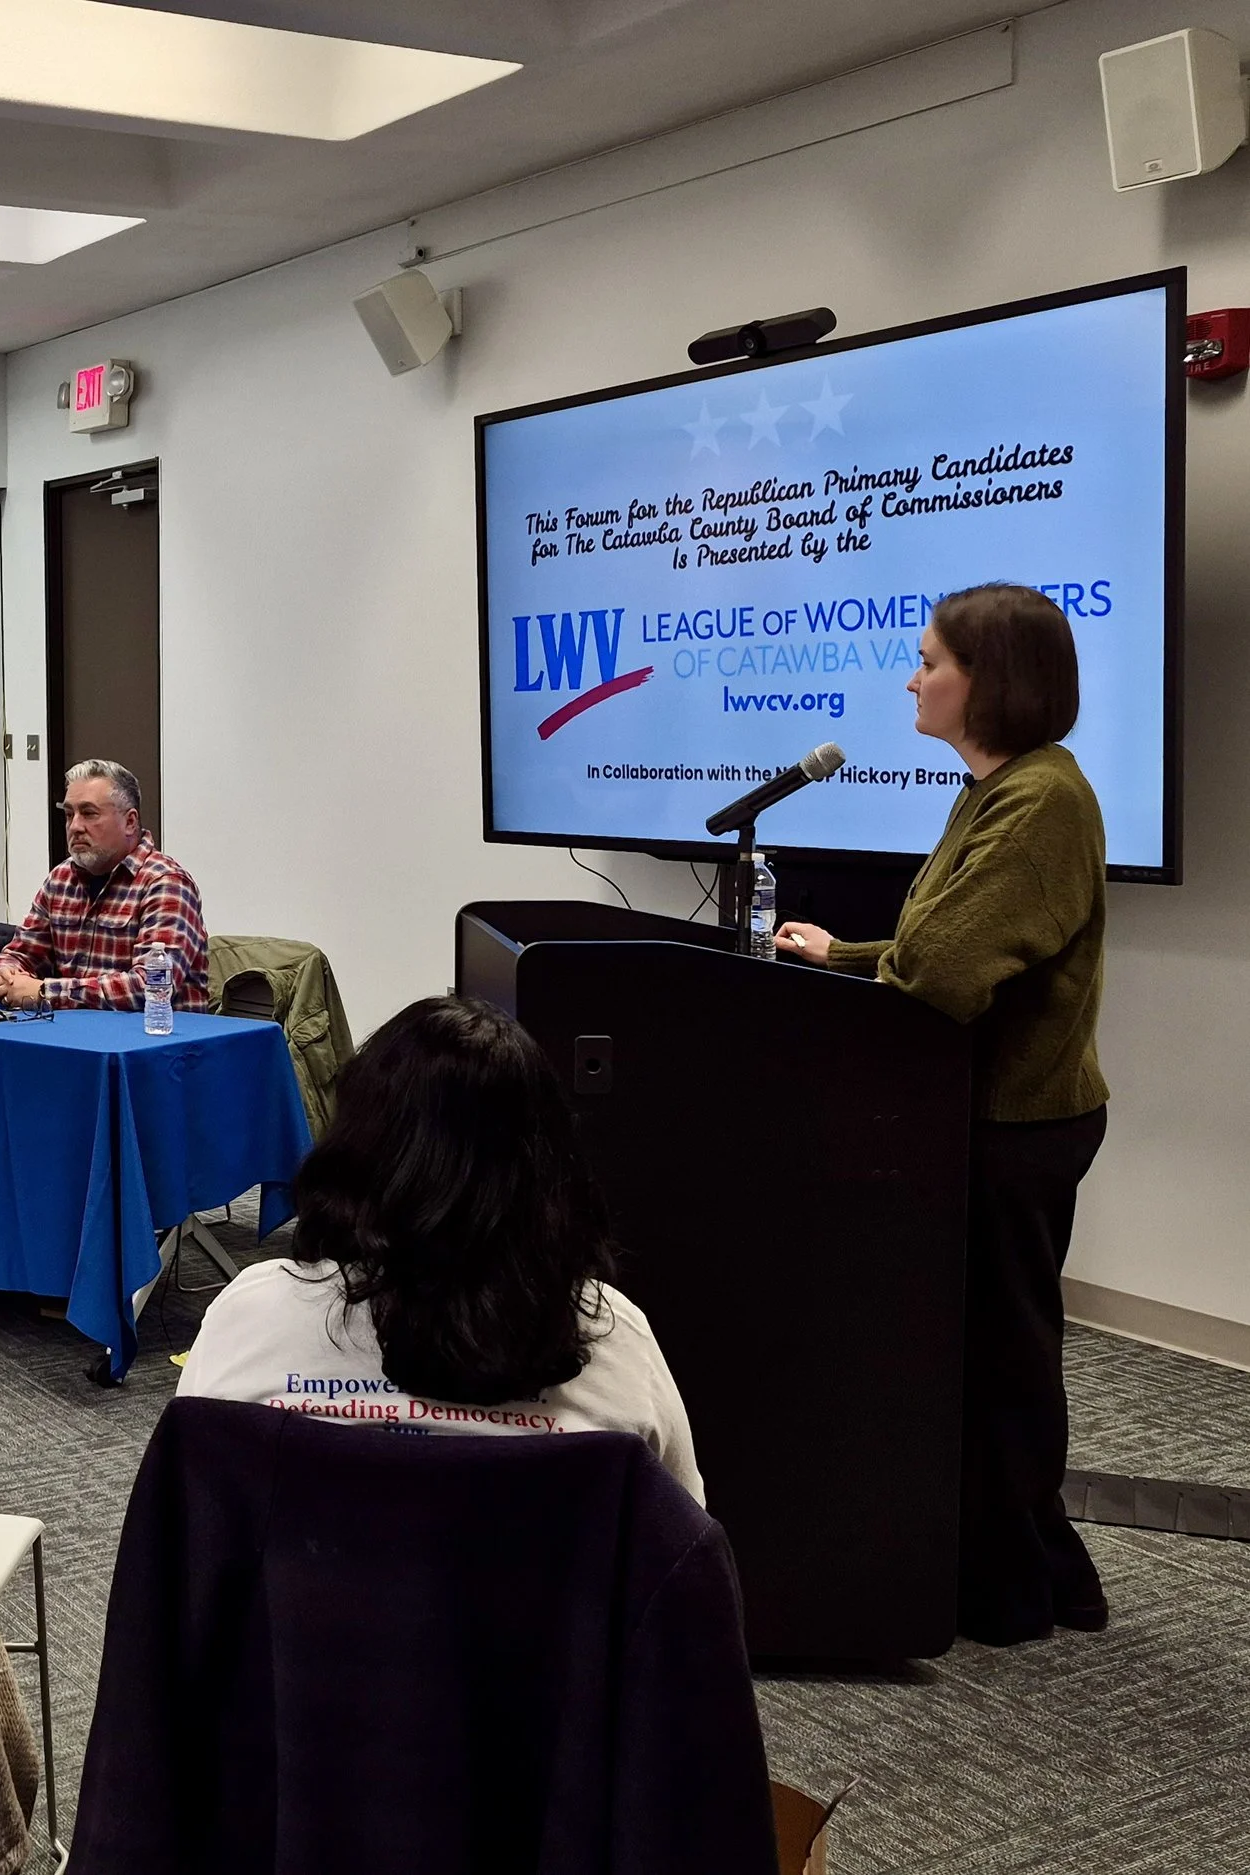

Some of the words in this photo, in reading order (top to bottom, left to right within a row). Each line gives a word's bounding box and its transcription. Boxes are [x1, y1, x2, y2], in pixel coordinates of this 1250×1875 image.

[76, 365, 104, 411] EXIT
[525, 511, 558, 535] This
[565, 507, 621, 530] Forum
[628, 499, 658, 528] for
[665, 493, 694, 516] the
[702, 477, 815, 516] Republican
[824, 465, 922, 496] Primary
[931, 443, 1074, 481] Candidates
[531, 538, 559, 566] for
[565, 533, 595, 555] The
[602, 522, 682, 551] Catawba
[689, 516, 758, 541] County
[766, 500, 837, 532] Board
[845, 495, 872, 529] of
[881, 478, 1064, 518] Commissioners
[673, 547, 687, 570] Is
[697, 535, 792, 568] Presented
[801, 531, 828, 563] by
[836, 527, 871, 552] the
[642, 606, 754, 643] LEAGUE
[762, 609, 797, 636] OF
[512, 608, 625, 692] LWV
[673, 647, 710, 679] OF
[716, 639, 863, 678] CATAWBA
[723, 685, 845, 718] lwvcv.org
[587, 764, 600, 779] In
[602, 763, 703, 781] Collaboration
[707, 764, 741, 781] with
[745, 765, 772, 782] the
[839, 765, 910, 790] Hickory
[269, 1398, 400, 1424] Defending
[407, 1399, 564, 1434] Democracy.
